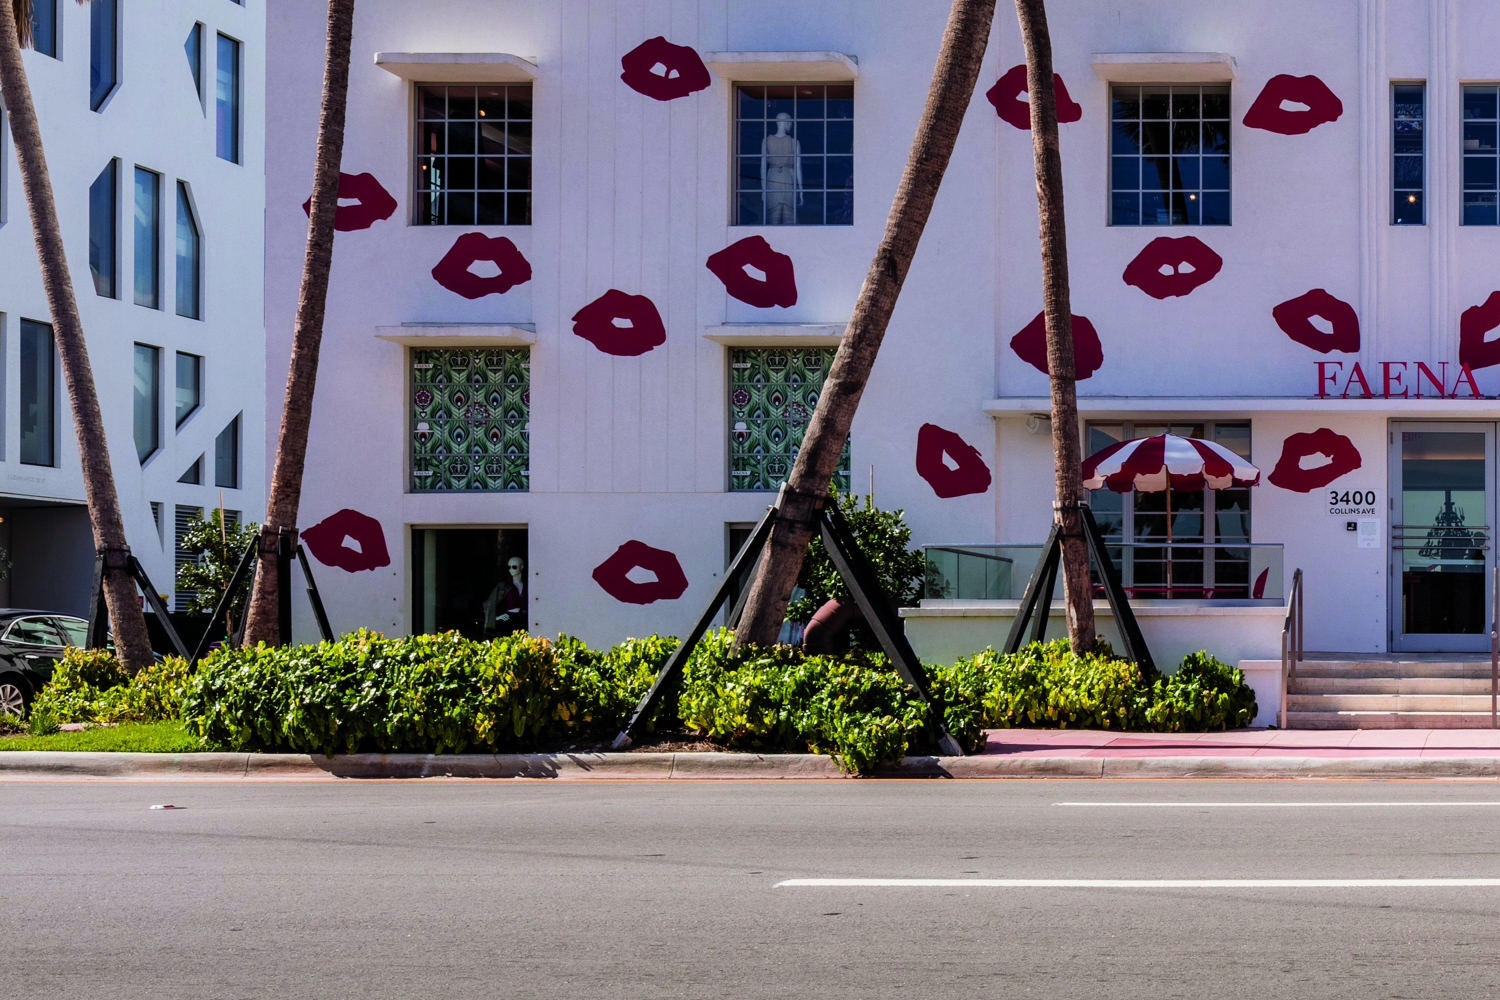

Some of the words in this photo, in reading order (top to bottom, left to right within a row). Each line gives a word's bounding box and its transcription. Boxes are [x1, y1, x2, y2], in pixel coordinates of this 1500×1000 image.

[1313, 361, 1485, 399] FAENA
[1329, 490, 1376, 506] 3400
[1329, 507, 1361, 515] COLLINS
[1361, 507, 1376, 515] AVE
